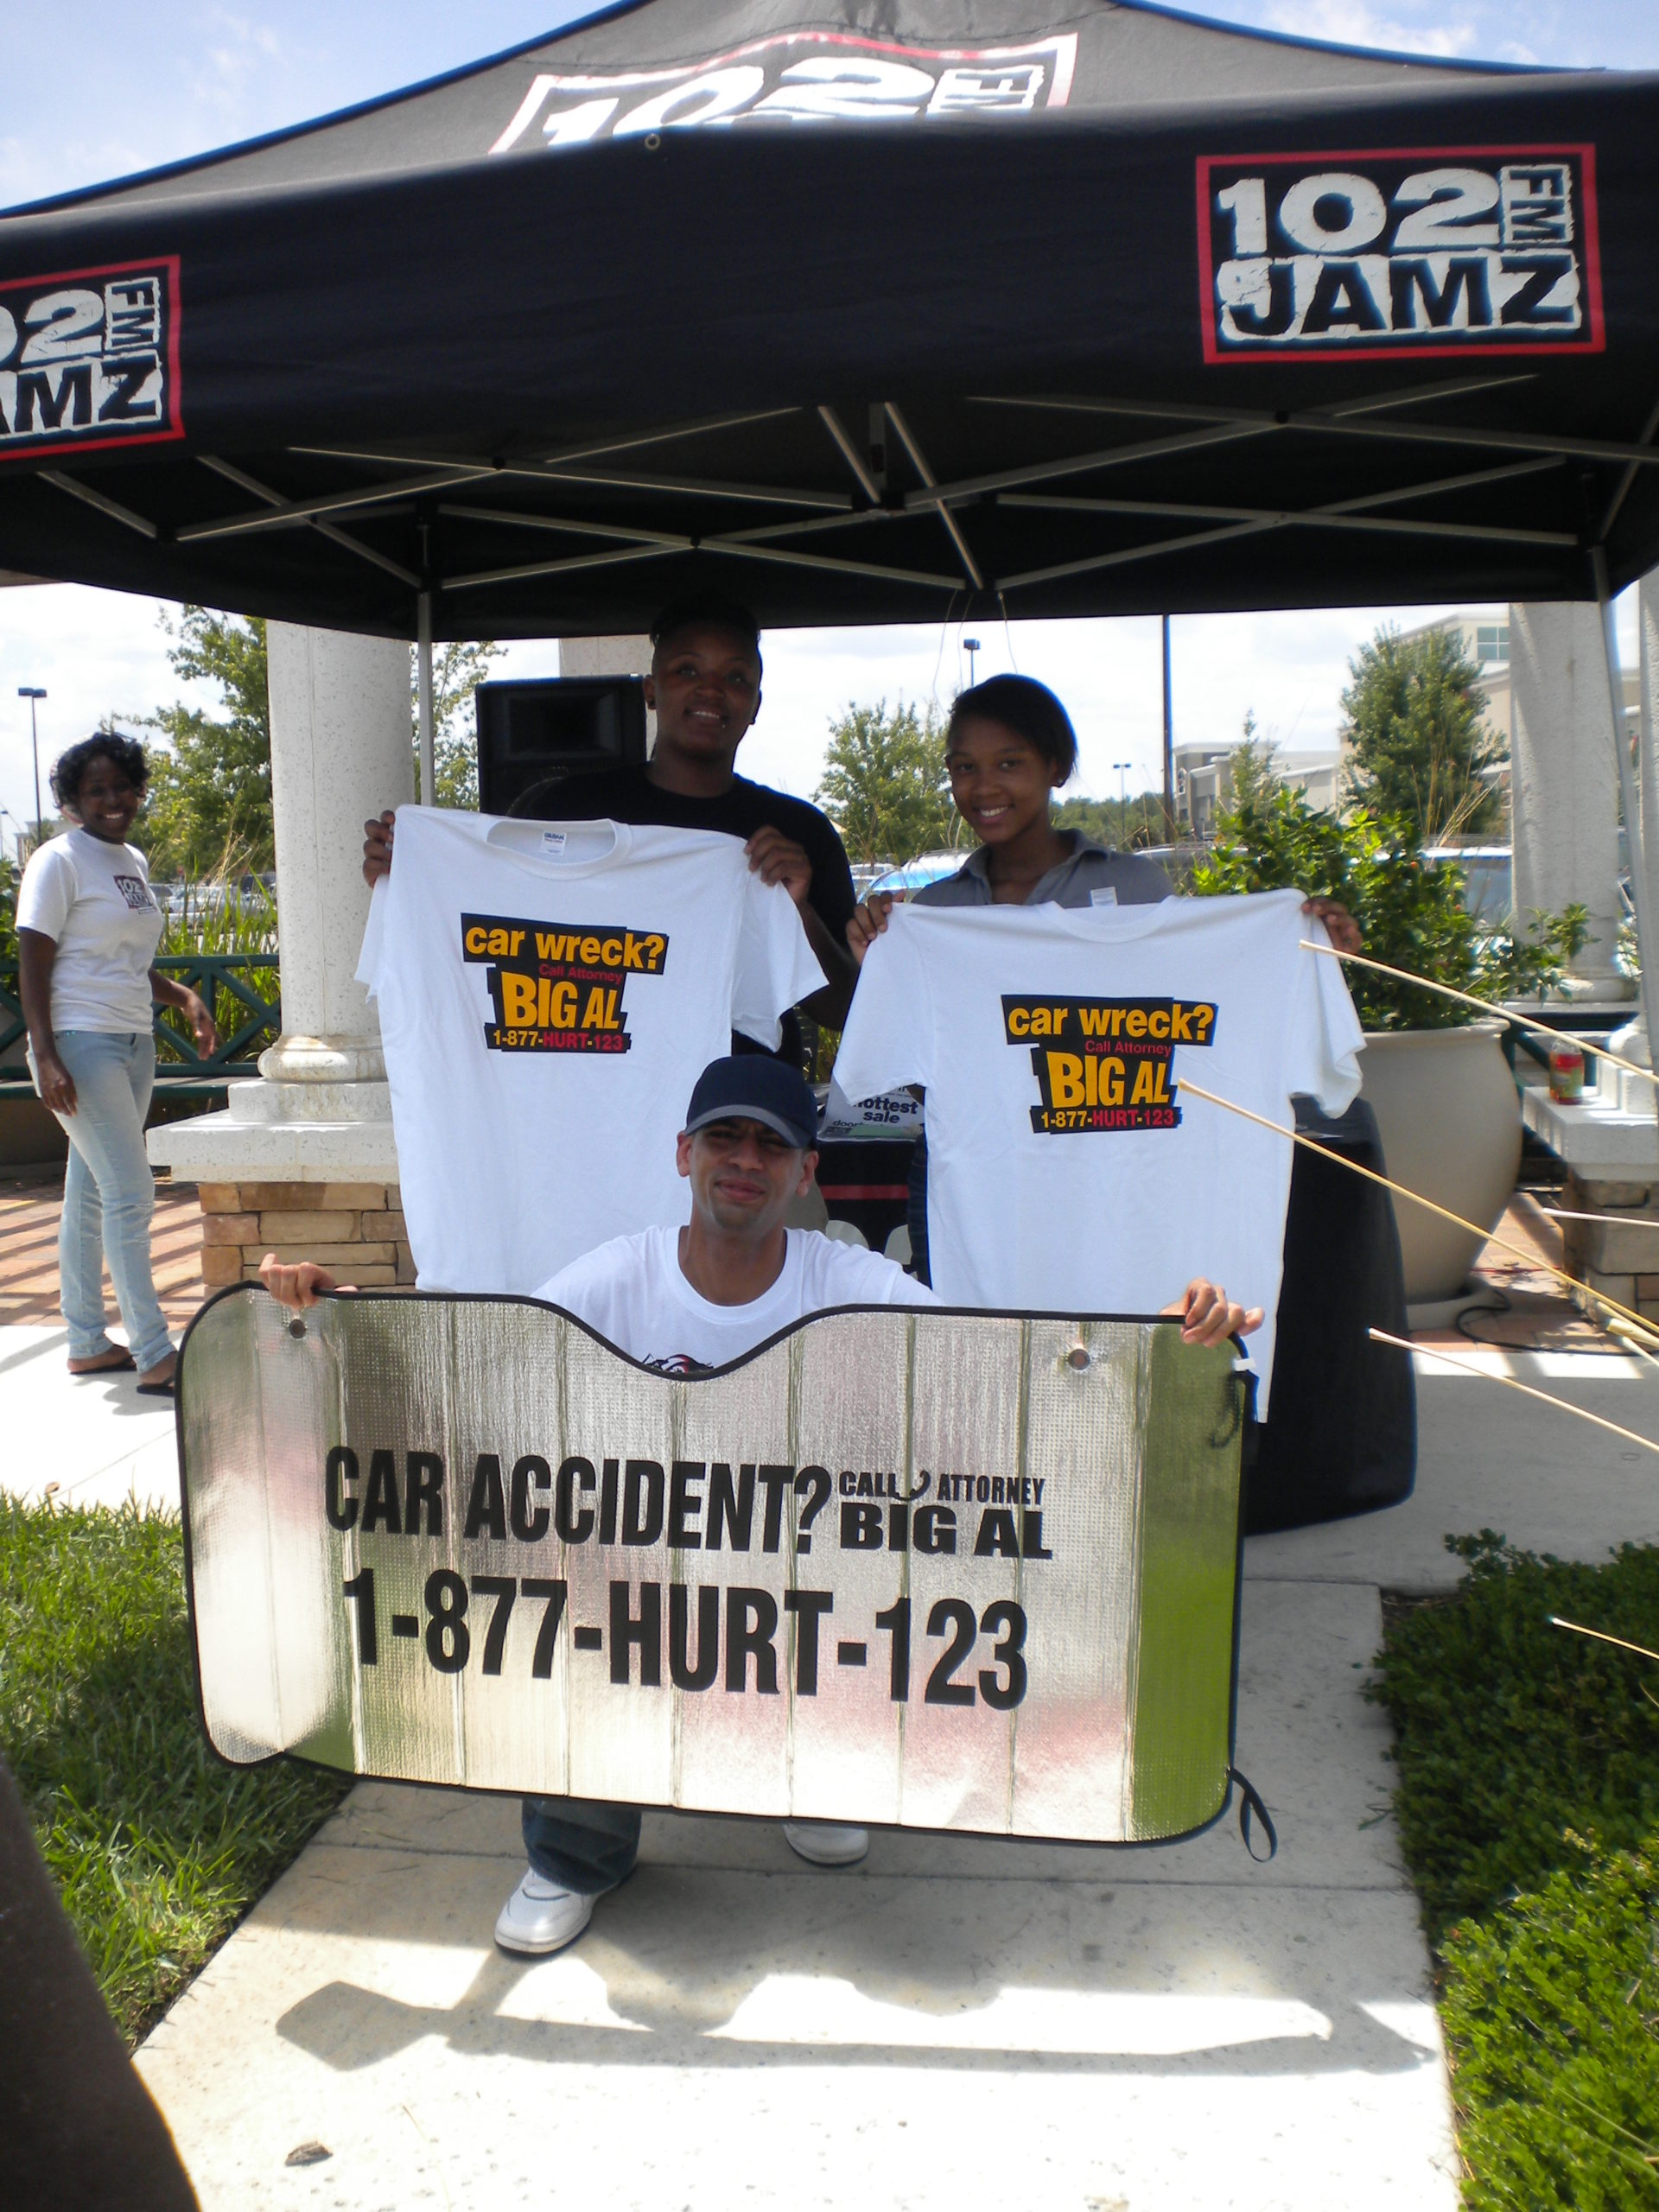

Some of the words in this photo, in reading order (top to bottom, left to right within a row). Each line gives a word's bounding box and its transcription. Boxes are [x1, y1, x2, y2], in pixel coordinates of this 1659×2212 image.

[543, 56, 935, 146] 102
[1218, 168, 1500, 254] 102
[1506, 167, 1569, 243] FM
[109, 279, 158, 347] FM
[1224, 252, 1578, 338] JAMZ
[0, 353, 159, 435] MZ
[465, 926, 525, 957] car
[535, 932, 664, 969] wreck?
[538, 963, 564, 976] Call
[568, 966, 623, 984] Attorney
[501, 971, 578, 1028] BIG
[581, 987, 620, 1029] AL
[1007, 1007, 1069, 1036] car
[1078, 1003, 1214, 1041] wreck?
[493, 1029, 624, 1051] 1-877-HURT-123
[1084, 1039, 1110, 1052] Call
[1115, 1041, 1172, 1057] Attorney
[1046, 1051, 1125, 1109] BIG
[1130, 1060, 1170, 1105] AL
[863, 1110, 900, 1124] sale
[1041, 1109, 1174, 1128] 1-877-HURT-123
[326, 1446, 444, 1536] CAR
[463, 1453, 832, 1554] ACCIDENT?
[839, 1471, 899, 1498] CALL
[938, 1473, 1046, 1506] ATTORNEY
[840, 1502, 957, 1555] BIG
[974, 1509, 1053, 1560] AL
[344, 1567, 1028, 1711] 1-877-HURT-123
